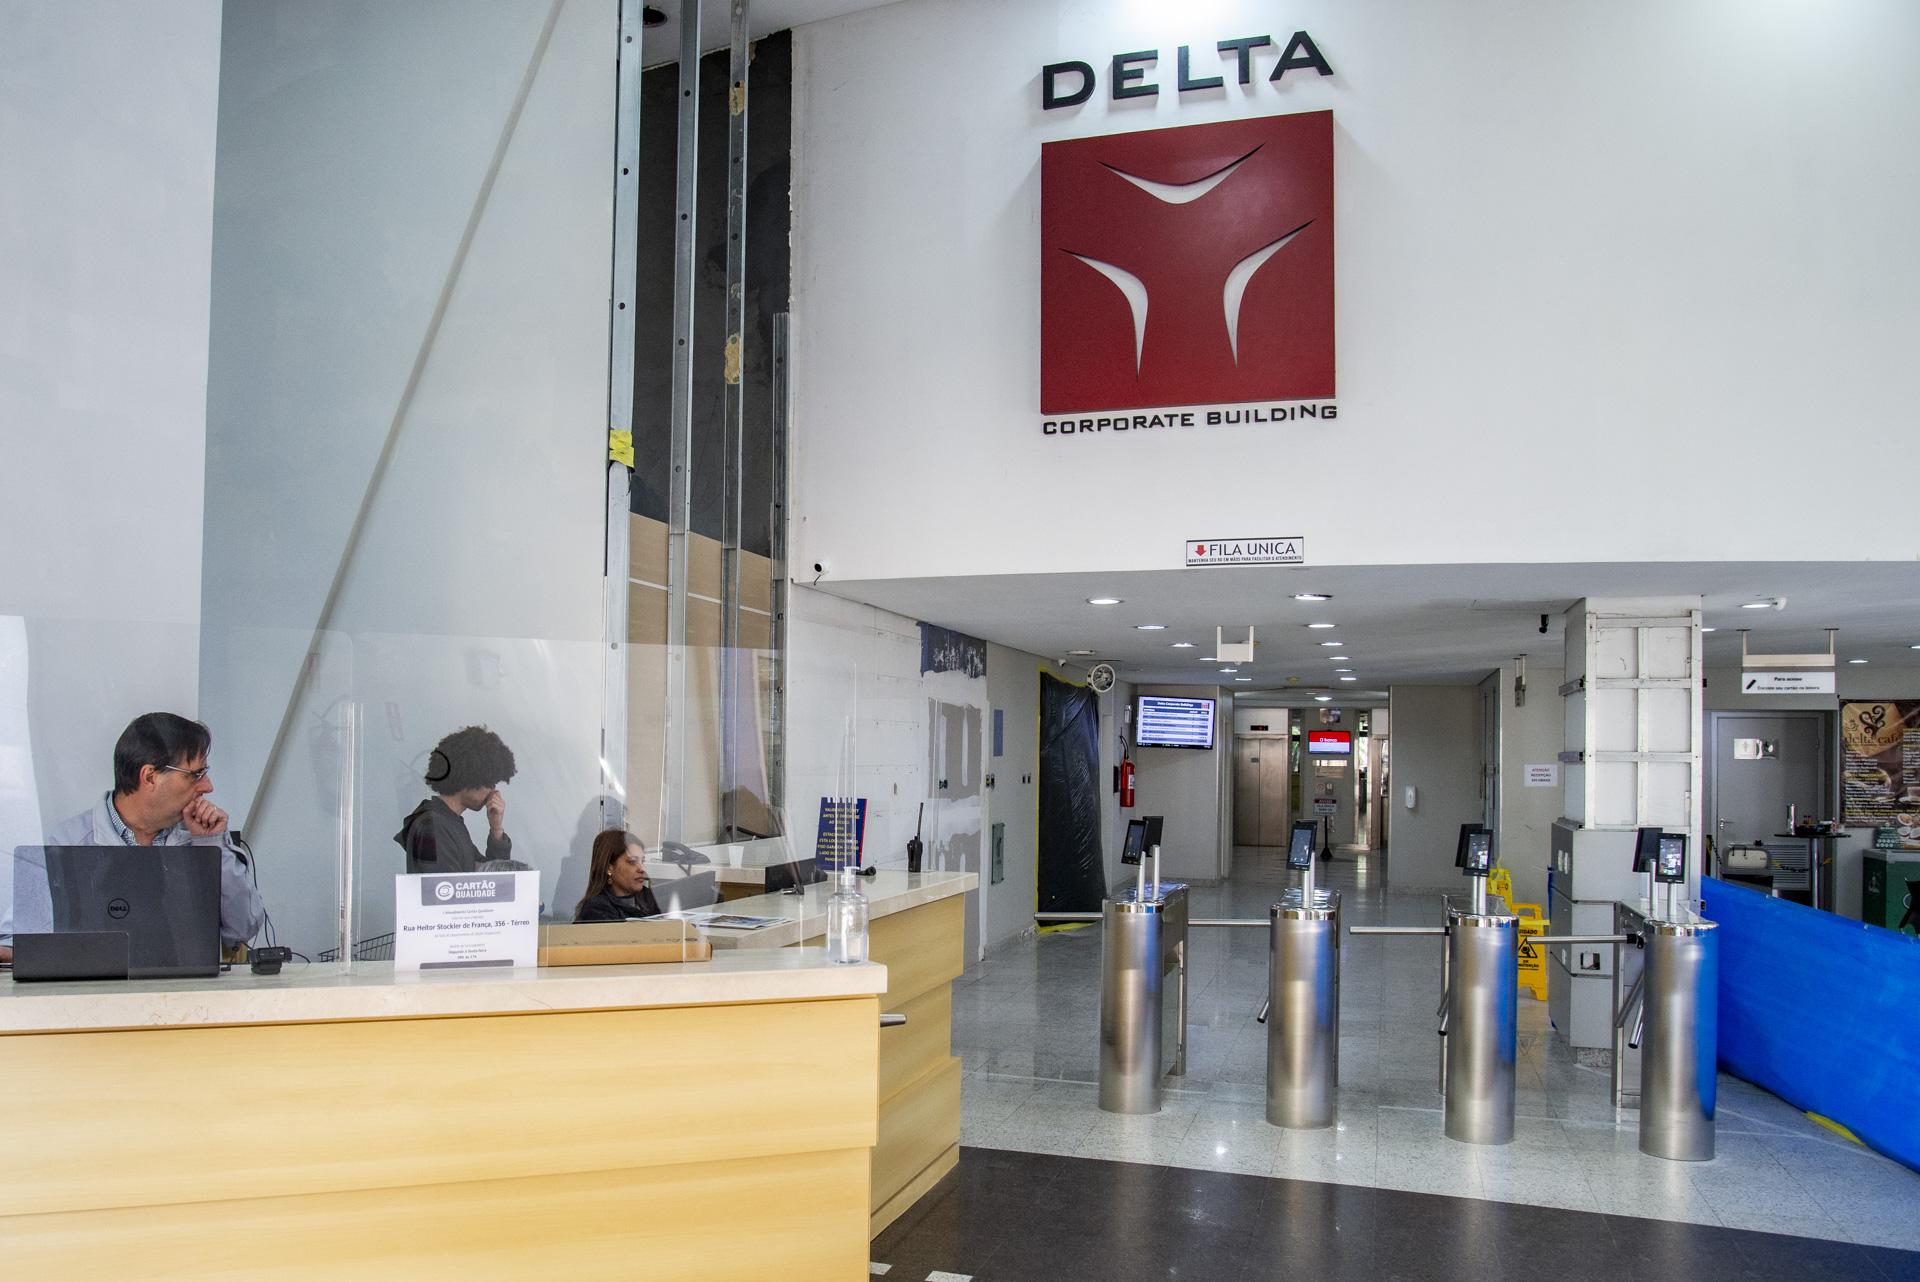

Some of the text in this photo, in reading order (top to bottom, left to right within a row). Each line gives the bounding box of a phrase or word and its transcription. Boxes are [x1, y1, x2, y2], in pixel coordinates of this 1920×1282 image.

[1042, 31, 1333, 110] DELTA
[1043, 404, 1338, 435] CORPORATE BUILDING
[1209, 542, 1296, 556] FILA UNICA
[455, 880, 496, 890] CARTÃO
[455, 889, 496, 898] QUALIDADE
[436, 922, 462, 931] Stockler
[471, 921, 493, 929] França,
